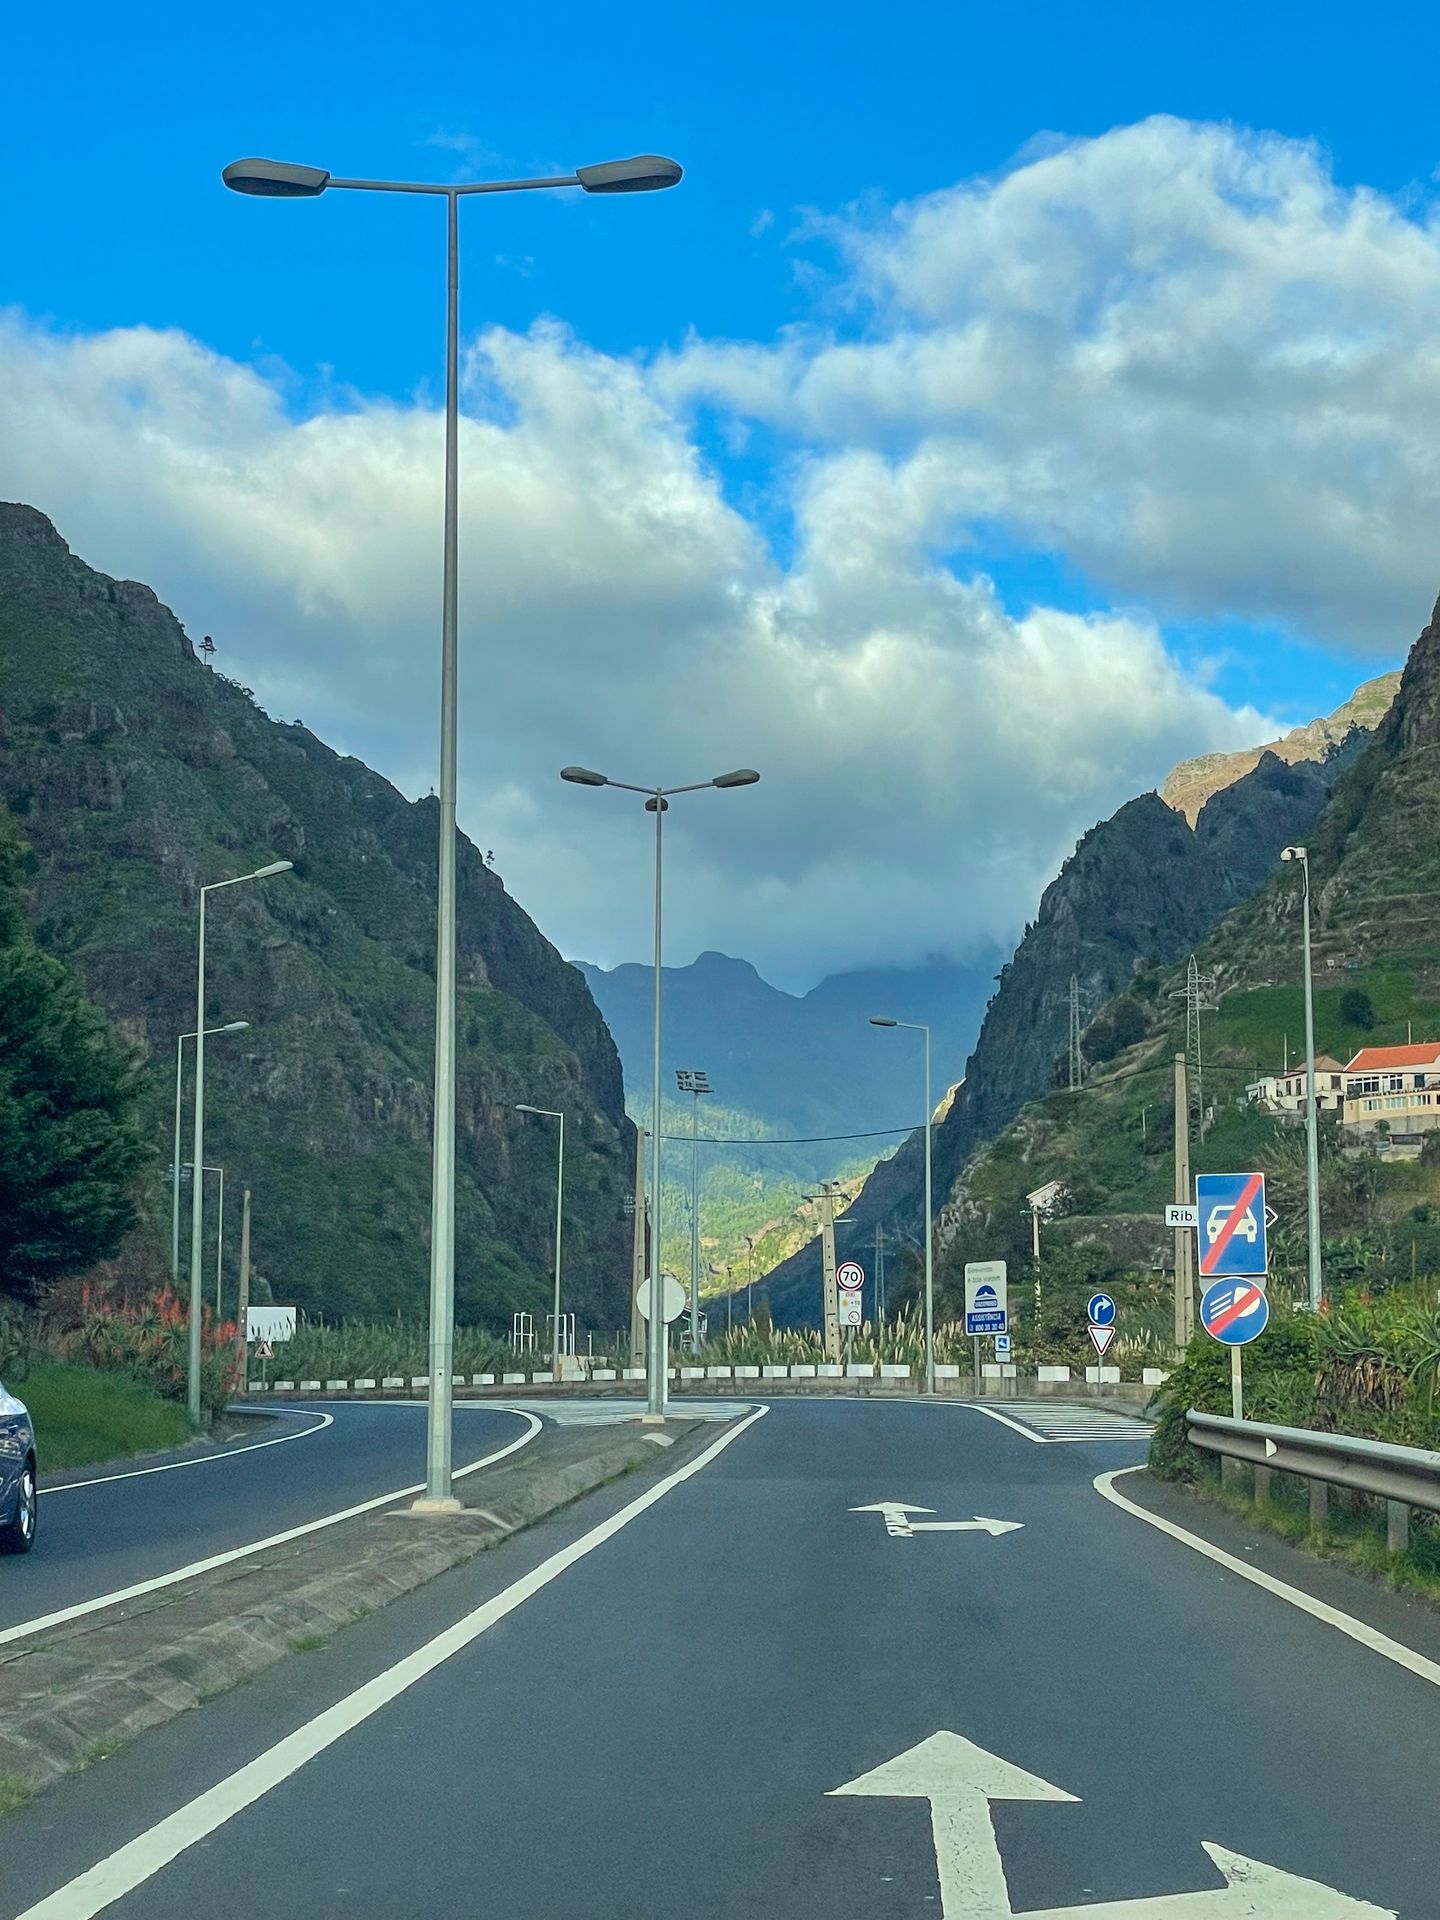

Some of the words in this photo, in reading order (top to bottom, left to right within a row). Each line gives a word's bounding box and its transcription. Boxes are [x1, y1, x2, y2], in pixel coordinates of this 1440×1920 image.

[1170, 1210, 1197, 1221] Rib.
[843, 1271, 859, 1282] 70
[972, 1313, 1001, 1321] ASSISTÊNCIA
